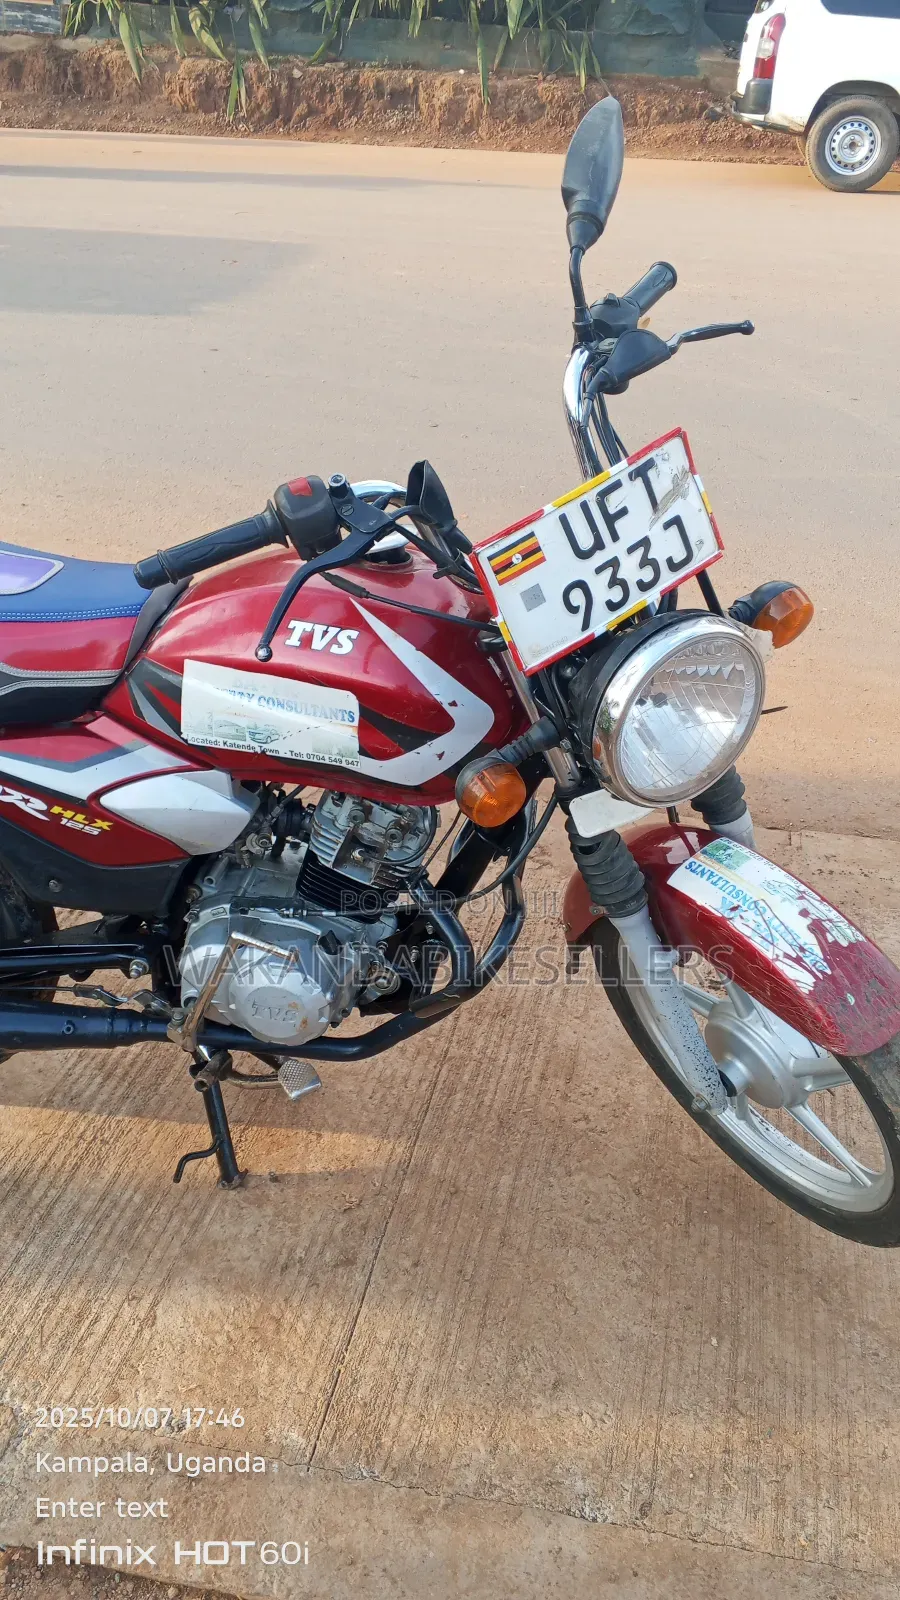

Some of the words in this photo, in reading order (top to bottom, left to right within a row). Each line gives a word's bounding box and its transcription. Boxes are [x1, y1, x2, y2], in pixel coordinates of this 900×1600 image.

[558, 457, 659, 560] UFT
[562, 514, 694, 632] 933J
[285, 620, 360, 655] TVS
[258, 696, 355, 723] CONSULTANTS
[50, 806, 113, 830] HLX
[60, 818, 101, 836] 125
[685, 862, 767, 918] CONSULTANTS
